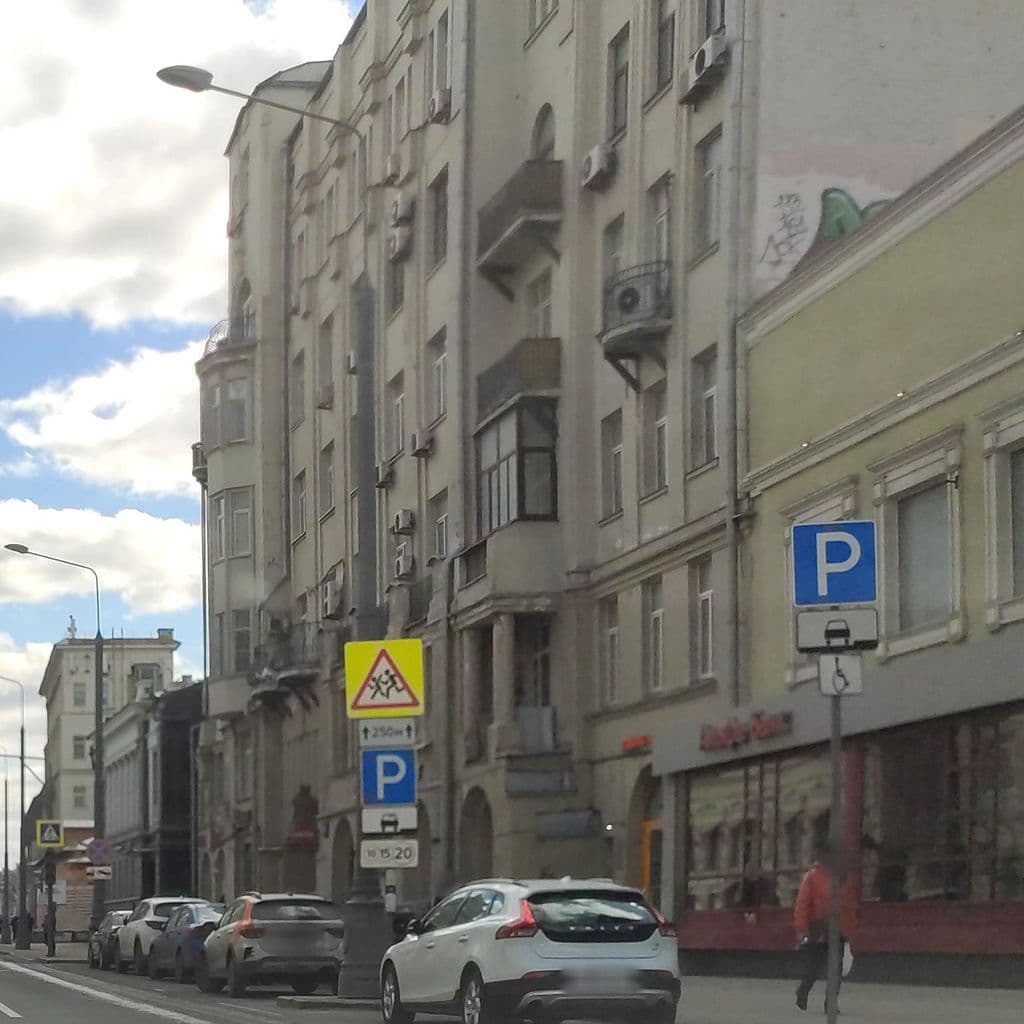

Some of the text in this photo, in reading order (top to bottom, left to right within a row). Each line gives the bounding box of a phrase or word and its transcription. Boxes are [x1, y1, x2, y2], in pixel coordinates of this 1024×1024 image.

[815, 531, 861, 597] P
[376, 754, 407, 800] P
[394, 846, 412, 860] 20
